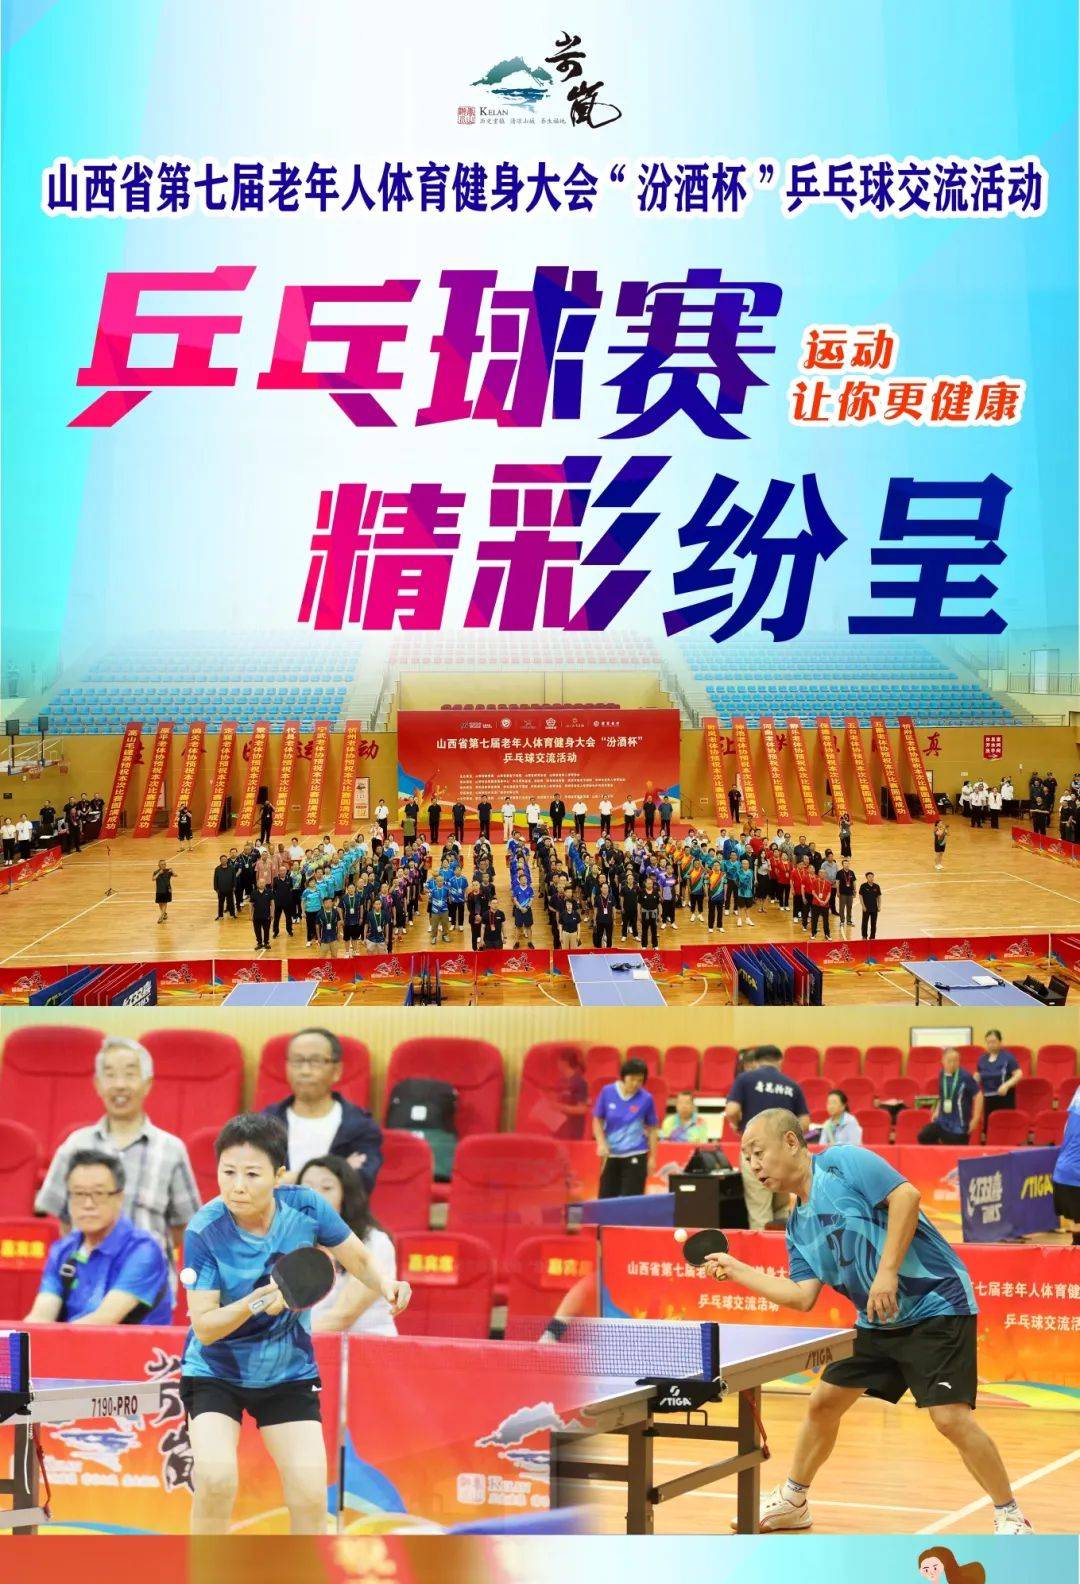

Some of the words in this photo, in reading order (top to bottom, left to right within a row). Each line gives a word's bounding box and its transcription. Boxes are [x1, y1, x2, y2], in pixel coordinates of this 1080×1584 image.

[503, 751, 577, 764] 乒乓球交流活动
[970, 1282, 1080, 1300] 七届老年人体育健
[91, 1394, 139, 1417] 7190-PRO
[659, 1397, 693, 1407] STIGA
